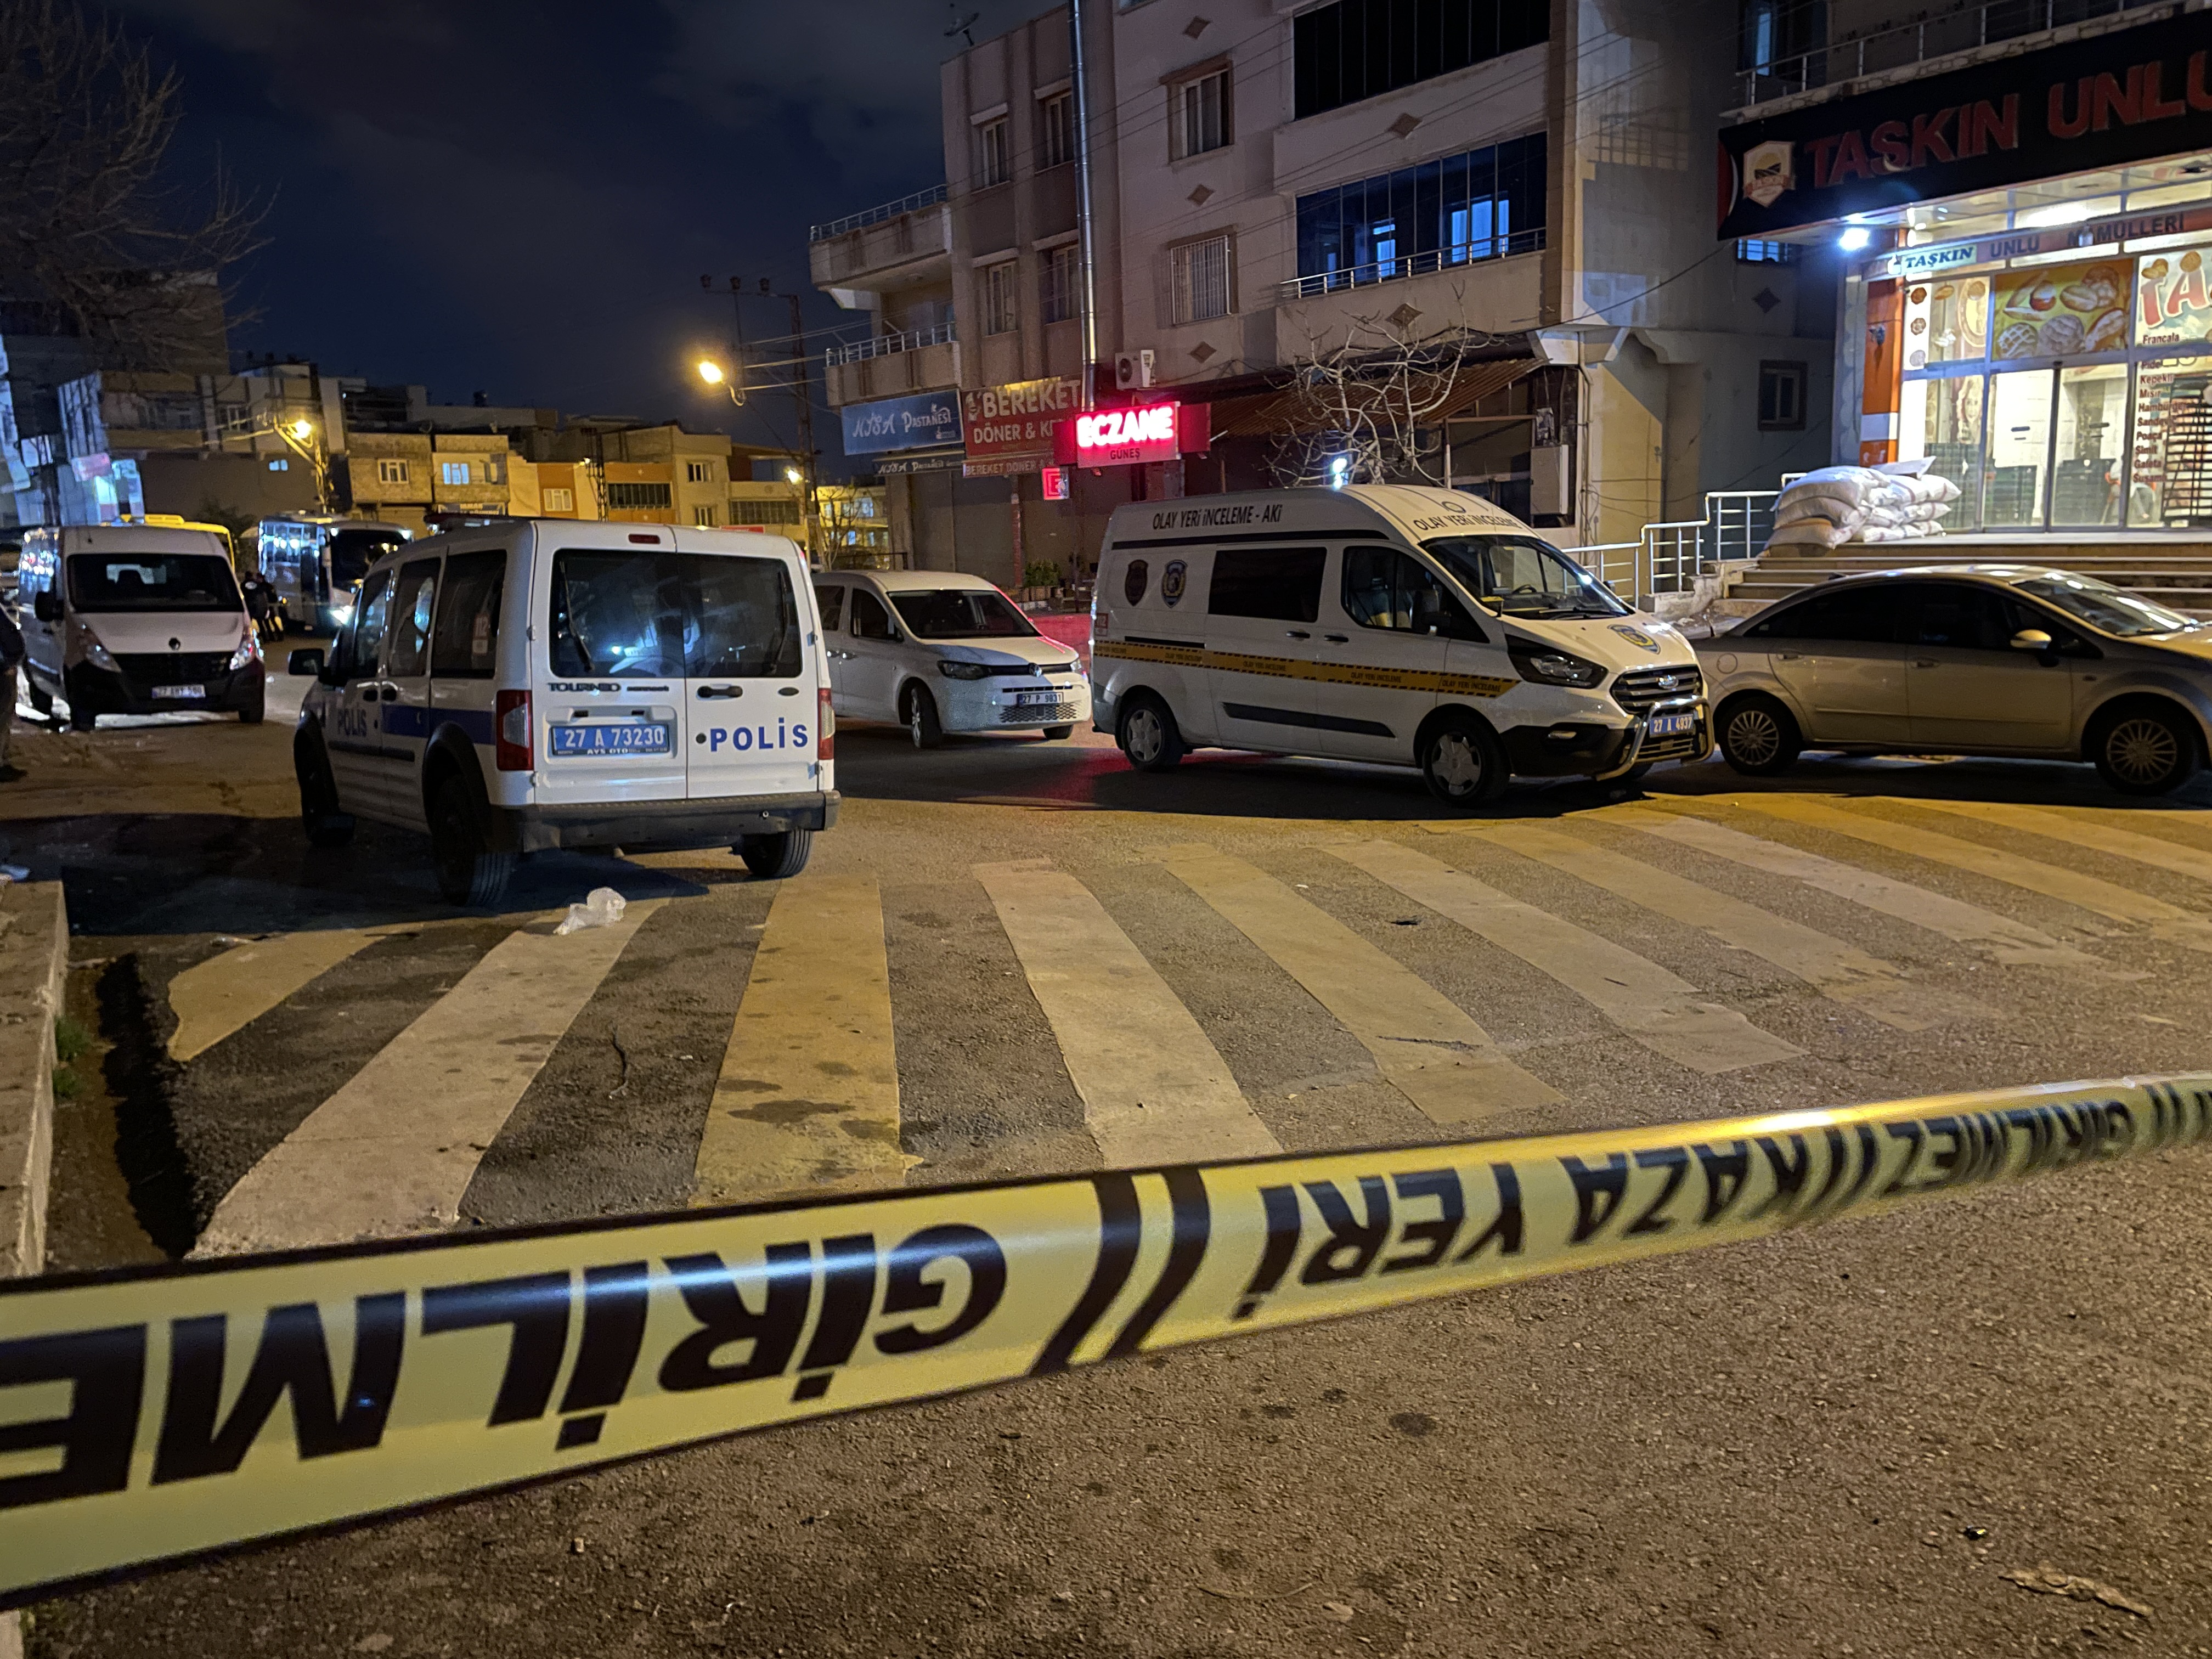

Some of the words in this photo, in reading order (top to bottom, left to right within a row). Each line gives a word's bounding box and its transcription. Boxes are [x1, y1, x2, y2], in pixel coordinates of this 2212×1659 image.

[1804, 92, 2020, 188] TAŞKIN
[1905, 247, 1973, 268] TAŞKIN
[2142, 333, 2180, 345] Francala
[2140, 374, 2173, 386] Kepekli
[982, 380, 1081, 419] BEREKET
[973, 422, 1022, 444] DÖNER
[1076, 405, 1174, 448] ECZANE
[1153, 511, 1178, 530] OLAY
[1413, 515, 1449, 531] OLAY
[1351, 672, 1364, 680] OLAY
[1442, 679, 1456, 687] OLAY
[1023, 695, 1031, 704] 27
[710, 717, 809, 752] POLİS
[1654, 719, 1663, 733] 27
[1667, 718, 1672, 731] A
[565, 729, 586, 748] 27
[595, 728, 605, 747] A
[611, 728, 664, 746] 73230
[1558, 1134, 1809, 1245] KAZA
[1232, 1161, 1523, 1318] YERİ
